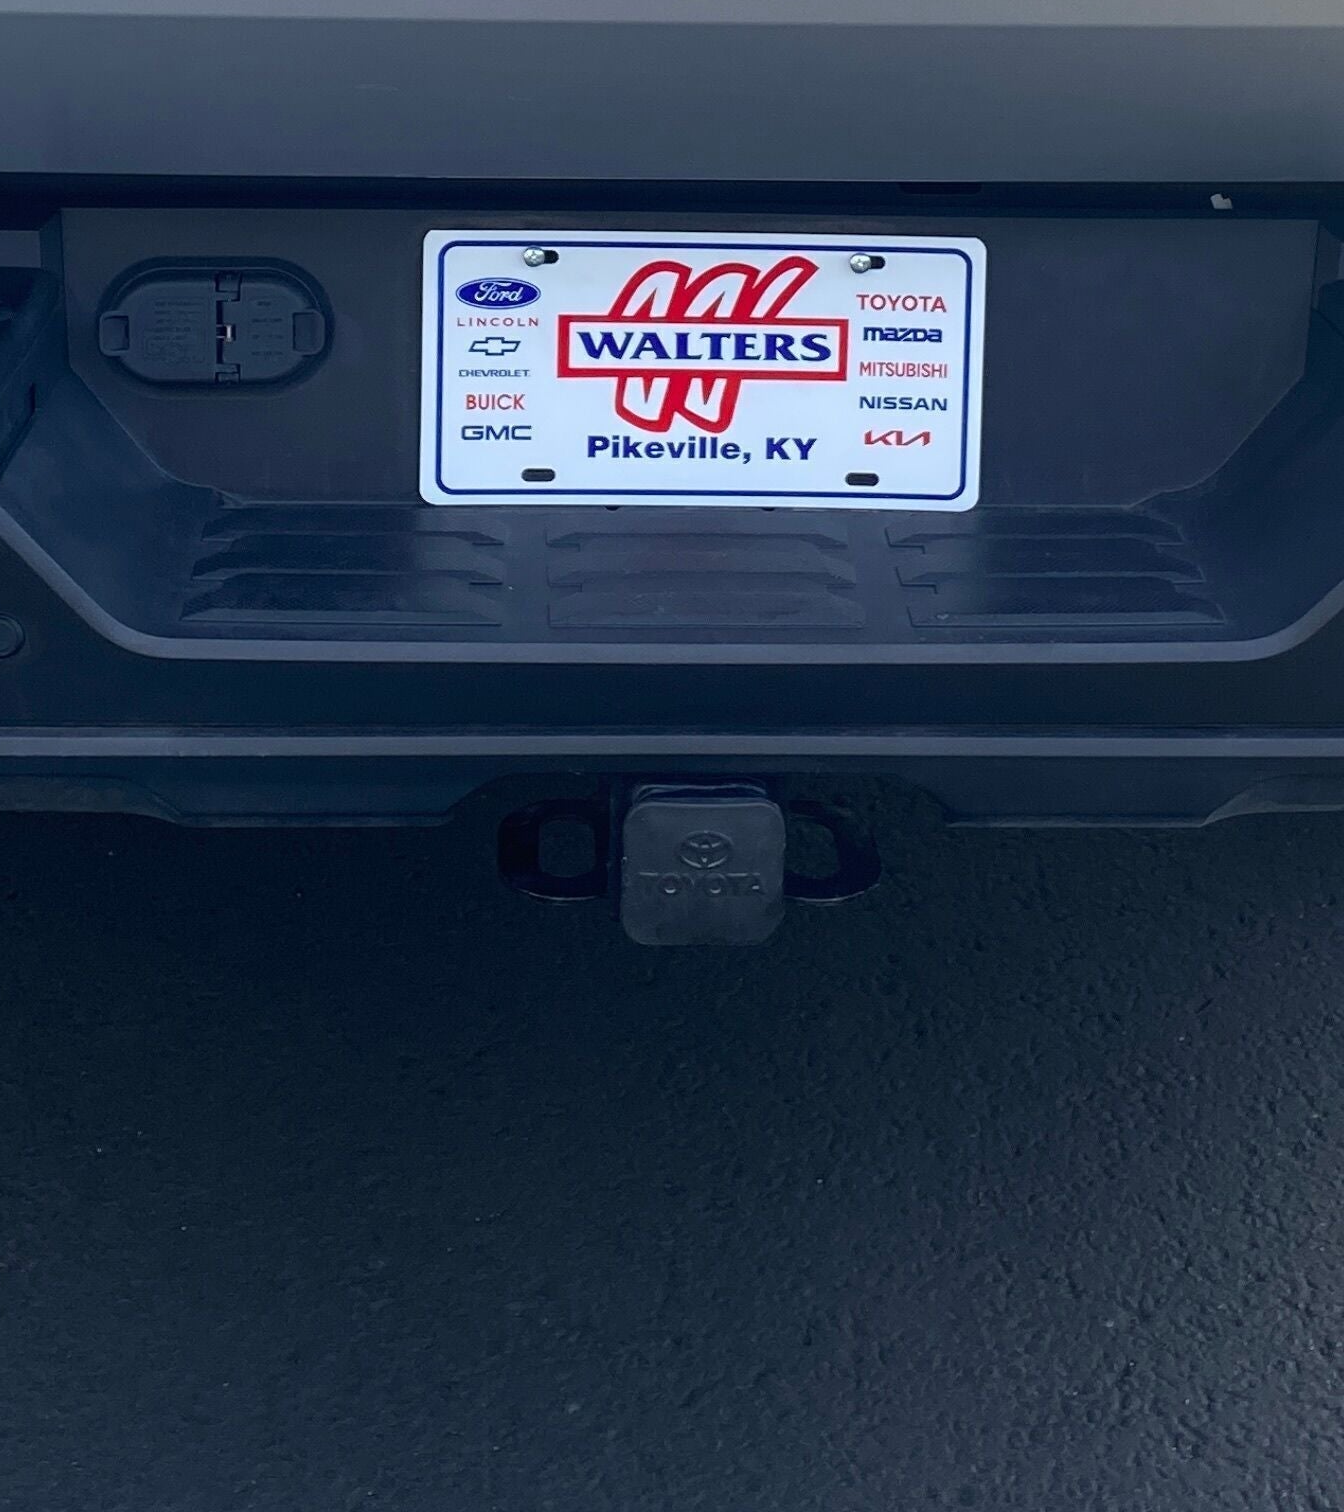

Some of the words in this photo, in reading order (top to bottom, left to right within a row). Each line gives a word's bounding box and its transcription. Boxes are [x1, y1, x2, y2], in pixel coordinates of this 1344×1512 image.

[473, 280, 524, 303] Ford
[856, 294, 947, 313] TOYOTA
[457, 316, 539, 327] LINCOLN
[575, 330, 832, 363] WALTERS
[458, 369, 530, 378] CHEVROLET
[859, 361, 948, 379] MITSUBISHI
[465, 394, 525, 411] BUICK
[859, 395, 948, 412] NISSAN
[460, 425, 532, 441] GMC
[587, 435, 751, 464] Pikeville,
[765, 437, 817, 461] KY
